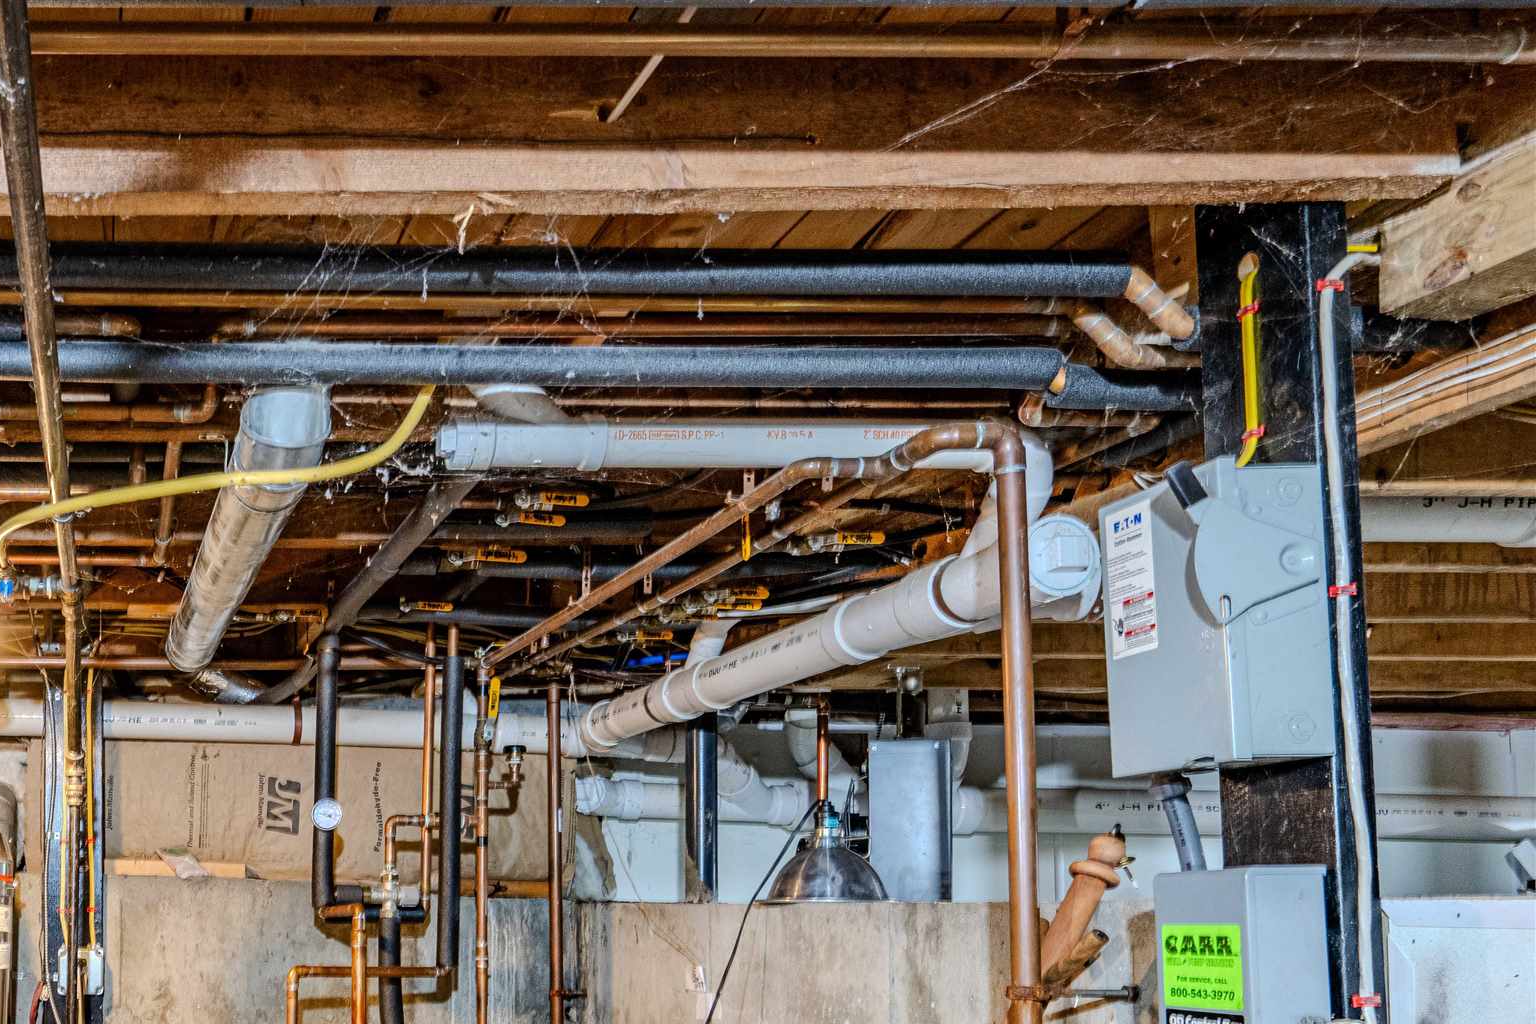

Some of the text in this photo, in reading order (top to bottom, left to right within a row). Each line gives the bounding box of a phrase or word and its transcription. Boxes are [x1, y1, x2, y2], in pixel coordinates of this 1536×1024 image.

[266, 776, 301, 836] JM
[374, 761, 383, 852] Formaldehyde-Free
[1165, 935, 1233, 956] CARR
[1170, 987, 1235, 1001] 800-543-3970
